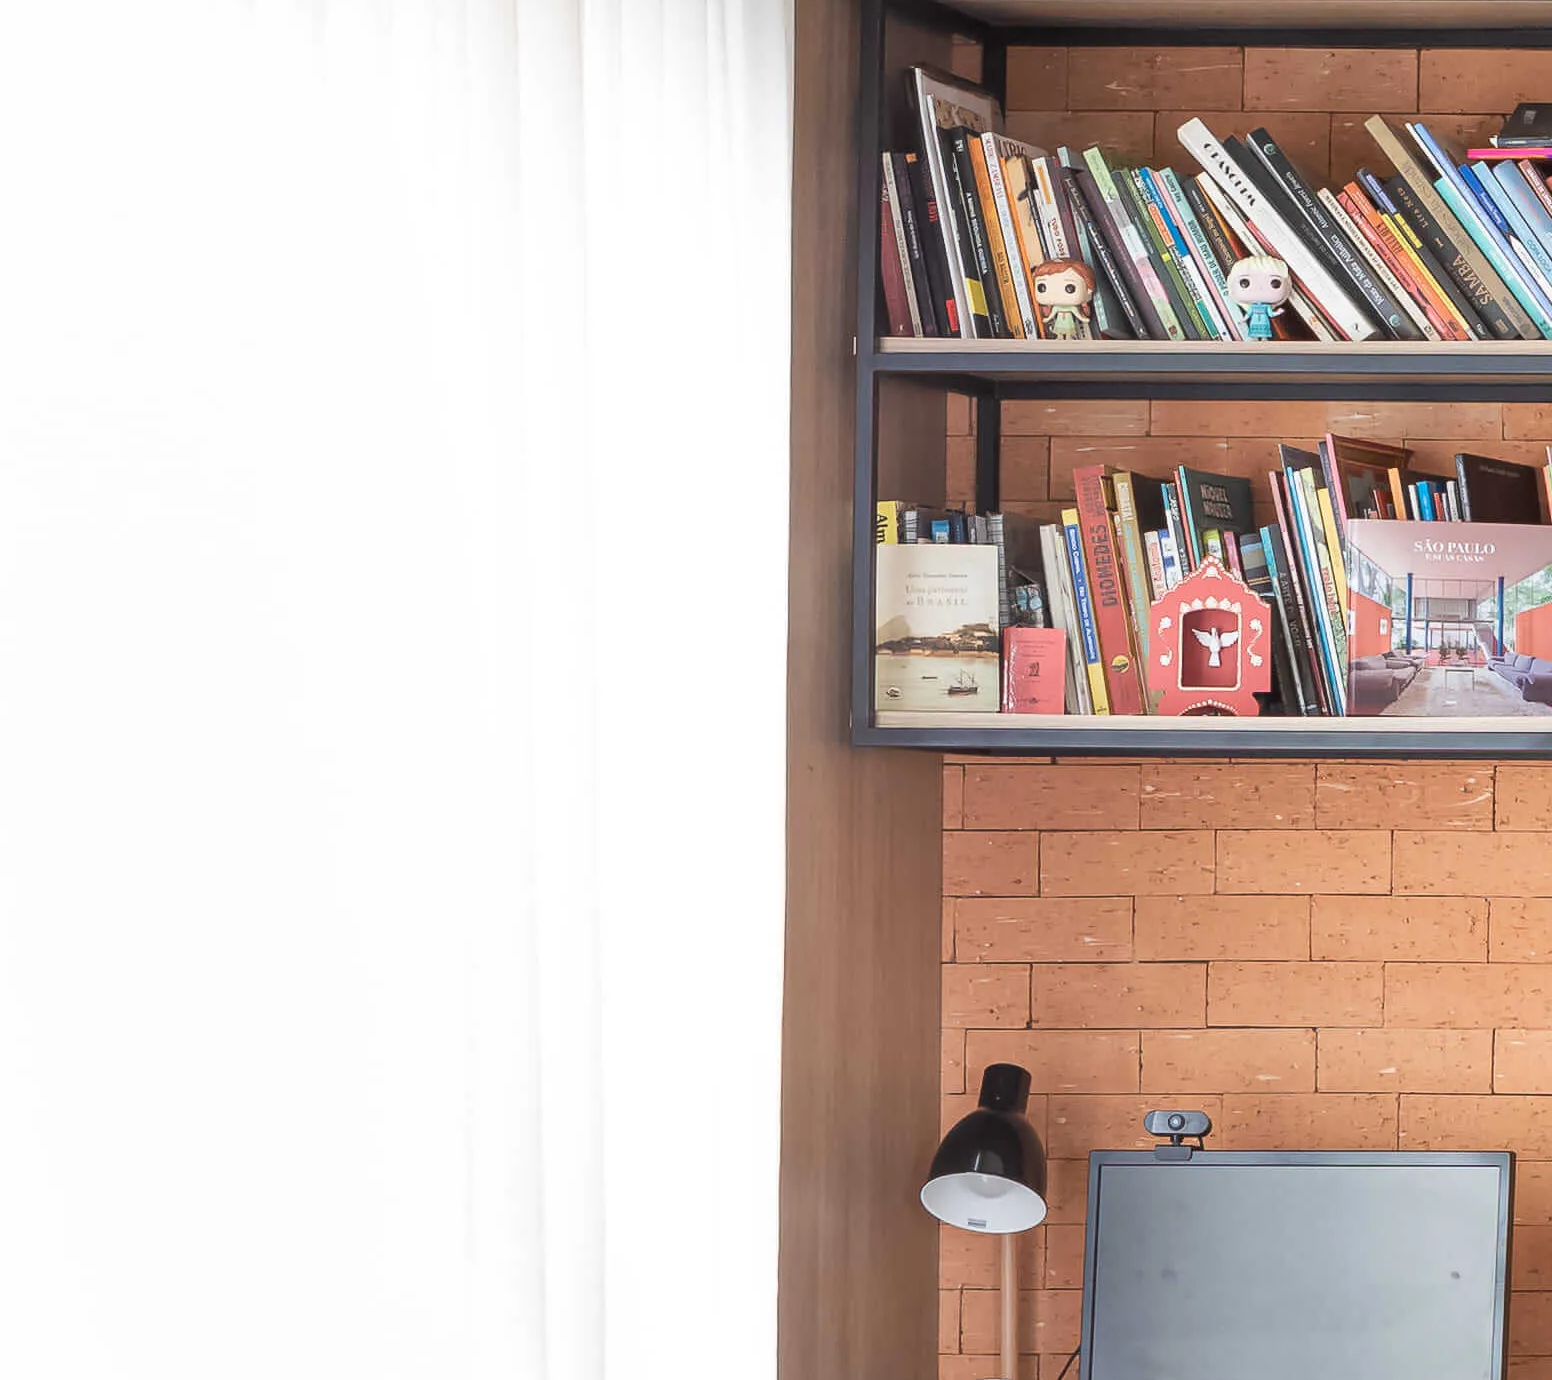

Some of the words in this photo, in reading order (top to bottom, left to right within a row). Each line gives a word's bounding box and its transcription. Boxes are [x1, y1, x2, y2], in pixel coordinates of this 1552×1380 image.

[1346, 259, 1368, 282] Mata
[1449, 252, 1494, 308] SAMBA
[1095, 523, 1118, 608] DIOMEDES
[1413, 538, 1444, 552] SÃO
[1446, 541, 1496, 555] PAULO
